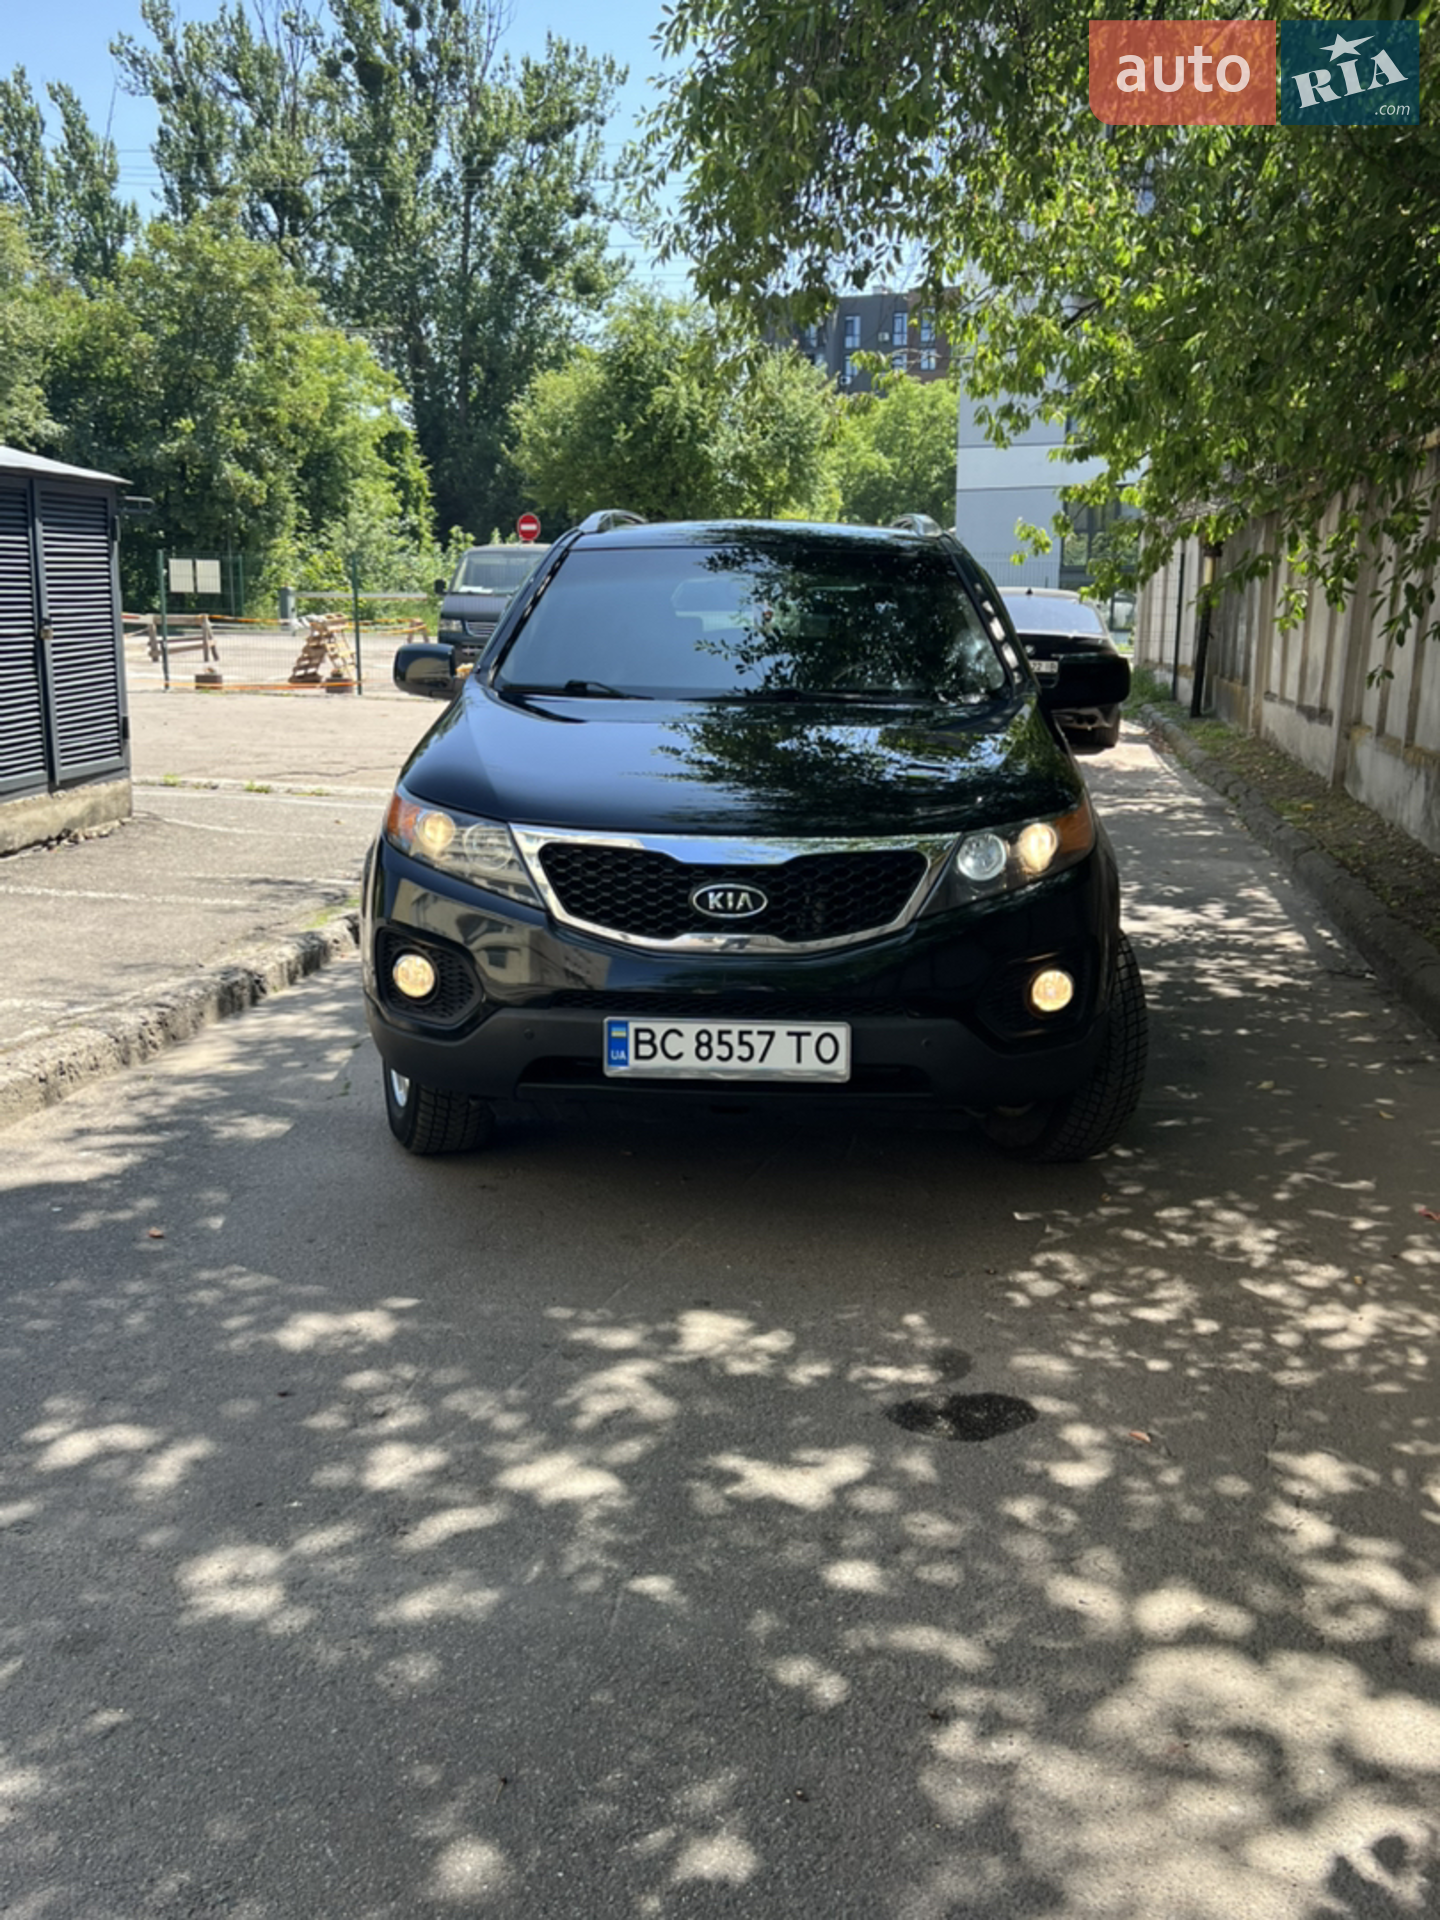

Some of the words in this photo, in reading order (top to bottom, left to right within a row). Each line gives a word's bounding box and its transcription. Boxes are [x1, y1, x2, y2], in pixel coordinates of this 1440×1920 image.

[708, 892, 753, 910] KIA
[611, 1050, 626, 1060] UA
[634, 1028, 684, 1061] BC
[694, 1029, 776, 1063] 8557
[786, 1031, 840, 1064] TO
